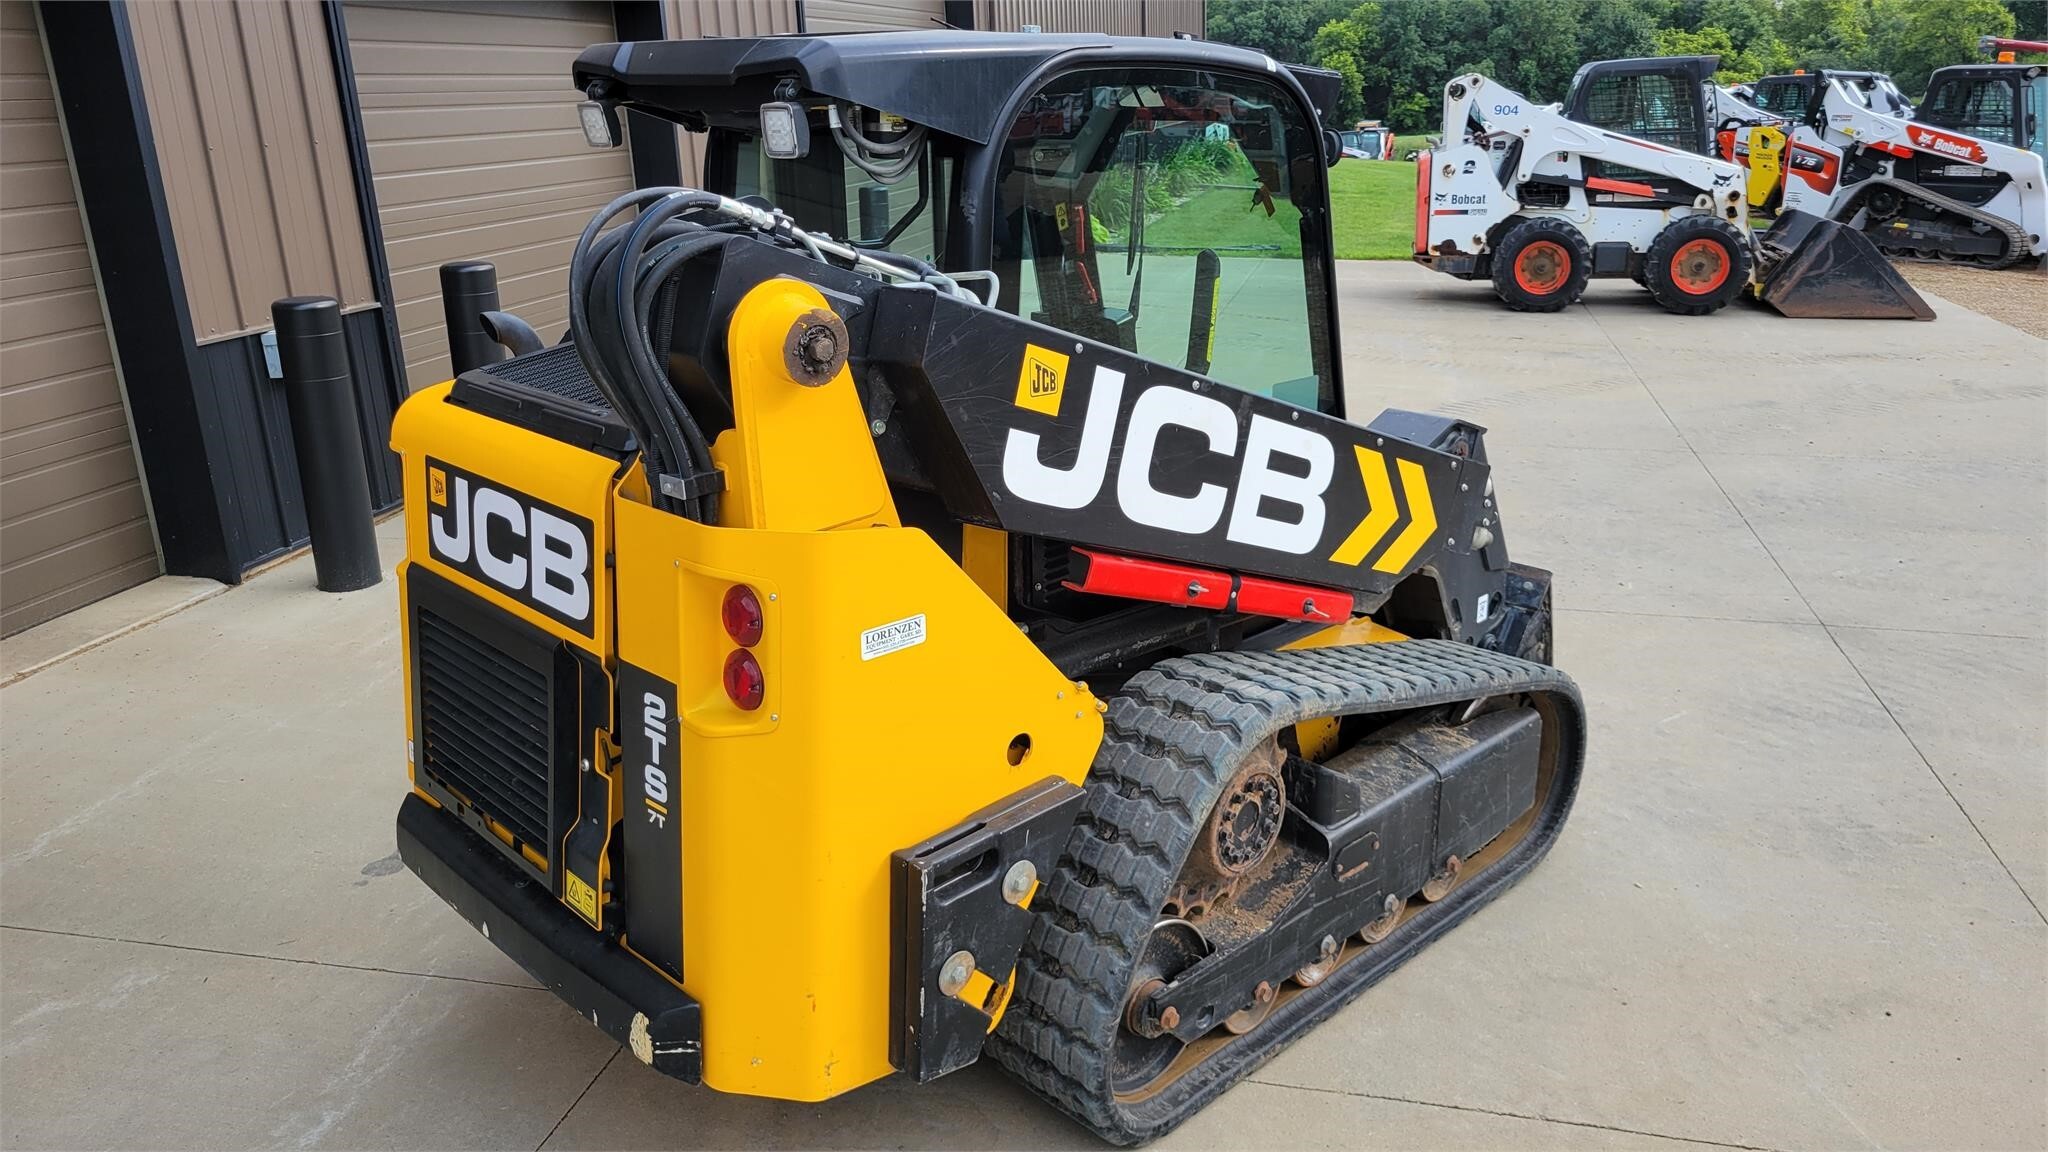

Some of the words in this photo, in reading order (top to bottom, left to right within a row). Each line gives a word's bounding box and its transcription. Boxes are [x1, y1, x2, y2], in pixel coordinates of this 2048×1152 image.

[1494, 105, 1519, 115] 904
[1934, 138, 1972, 157] Bobcat
[1795, 155, 1817, 166] T76
[1451, 194, 1486, 204] Bobcat
[1033, 364, 1056, 393] JCB
[1003, 365, 1335, 554] JCB
[431, 476, 590, 621] JCB
[866, 619, 921, 645] LORENZEN
[866, 637, 896, 650] EQUIPMENT
[644, 692, 668, 804] 2TS
[647, 808, 666, 829] 7T
